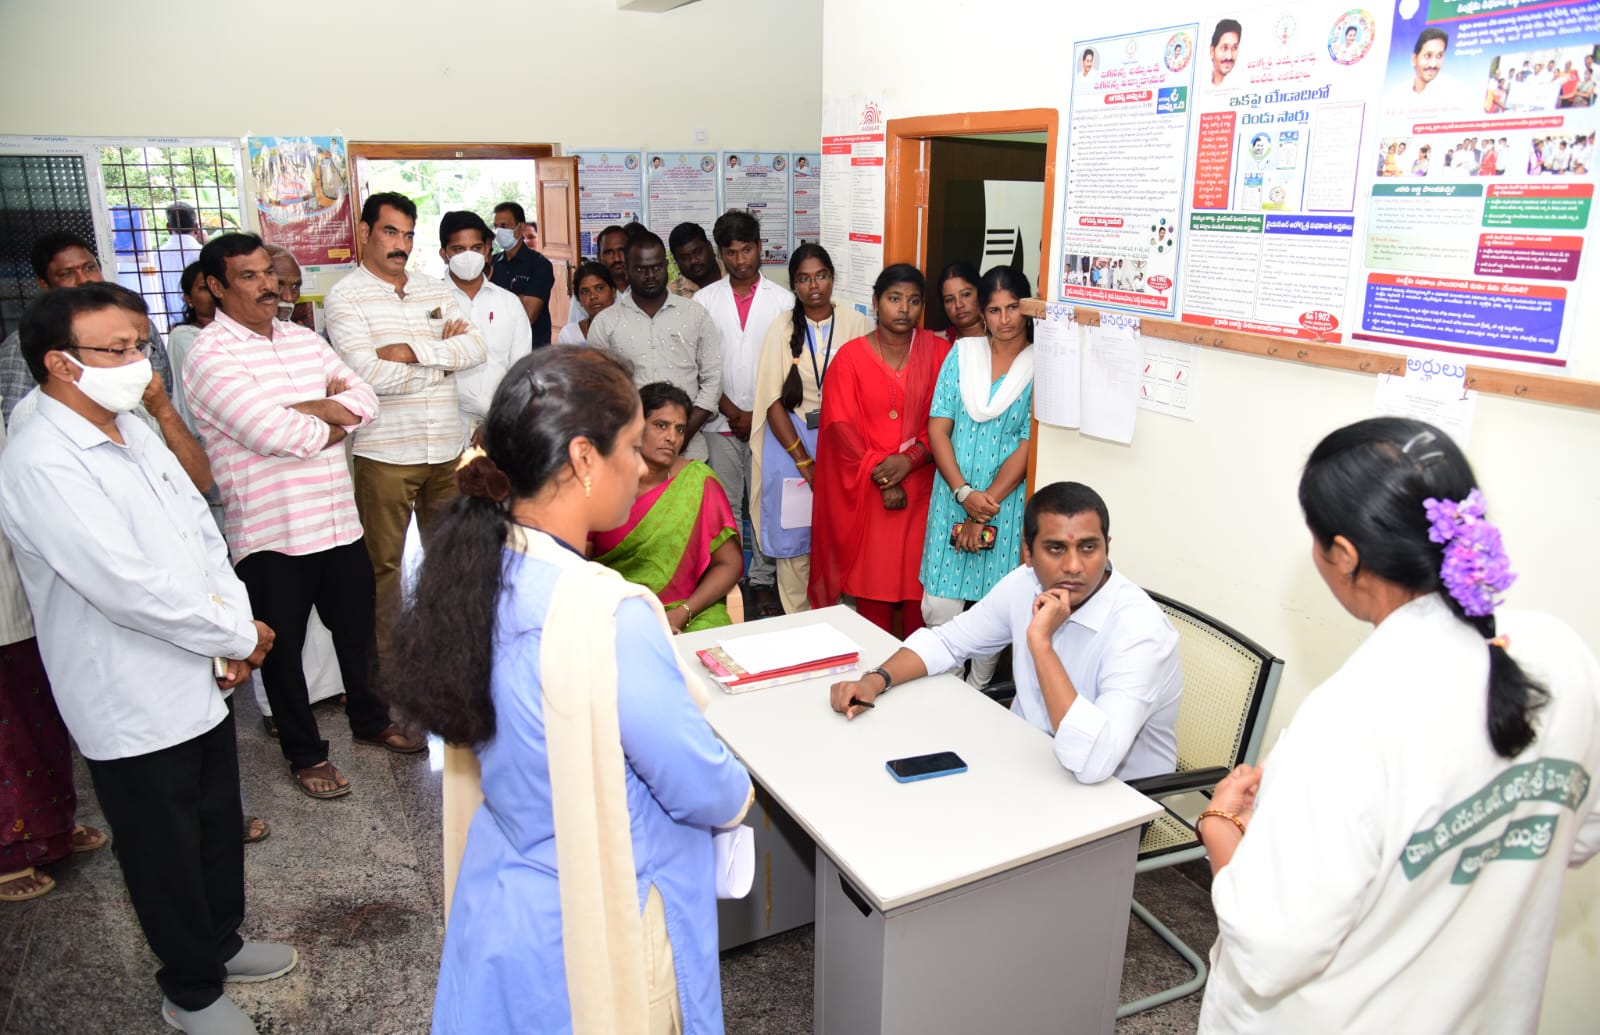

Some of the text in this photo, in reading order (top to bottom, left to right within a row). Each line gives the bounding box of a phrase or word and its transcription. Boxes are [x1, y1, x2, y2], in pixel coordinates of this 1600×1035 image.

[1229, 84, 1332, 108] ఇకపై యేడాదిలో
[1242, 113, 1275, 125] రెండు
[1315, 312, 1330, 321] 1902
[1407, 357, 1465, 382] అర్హులు
